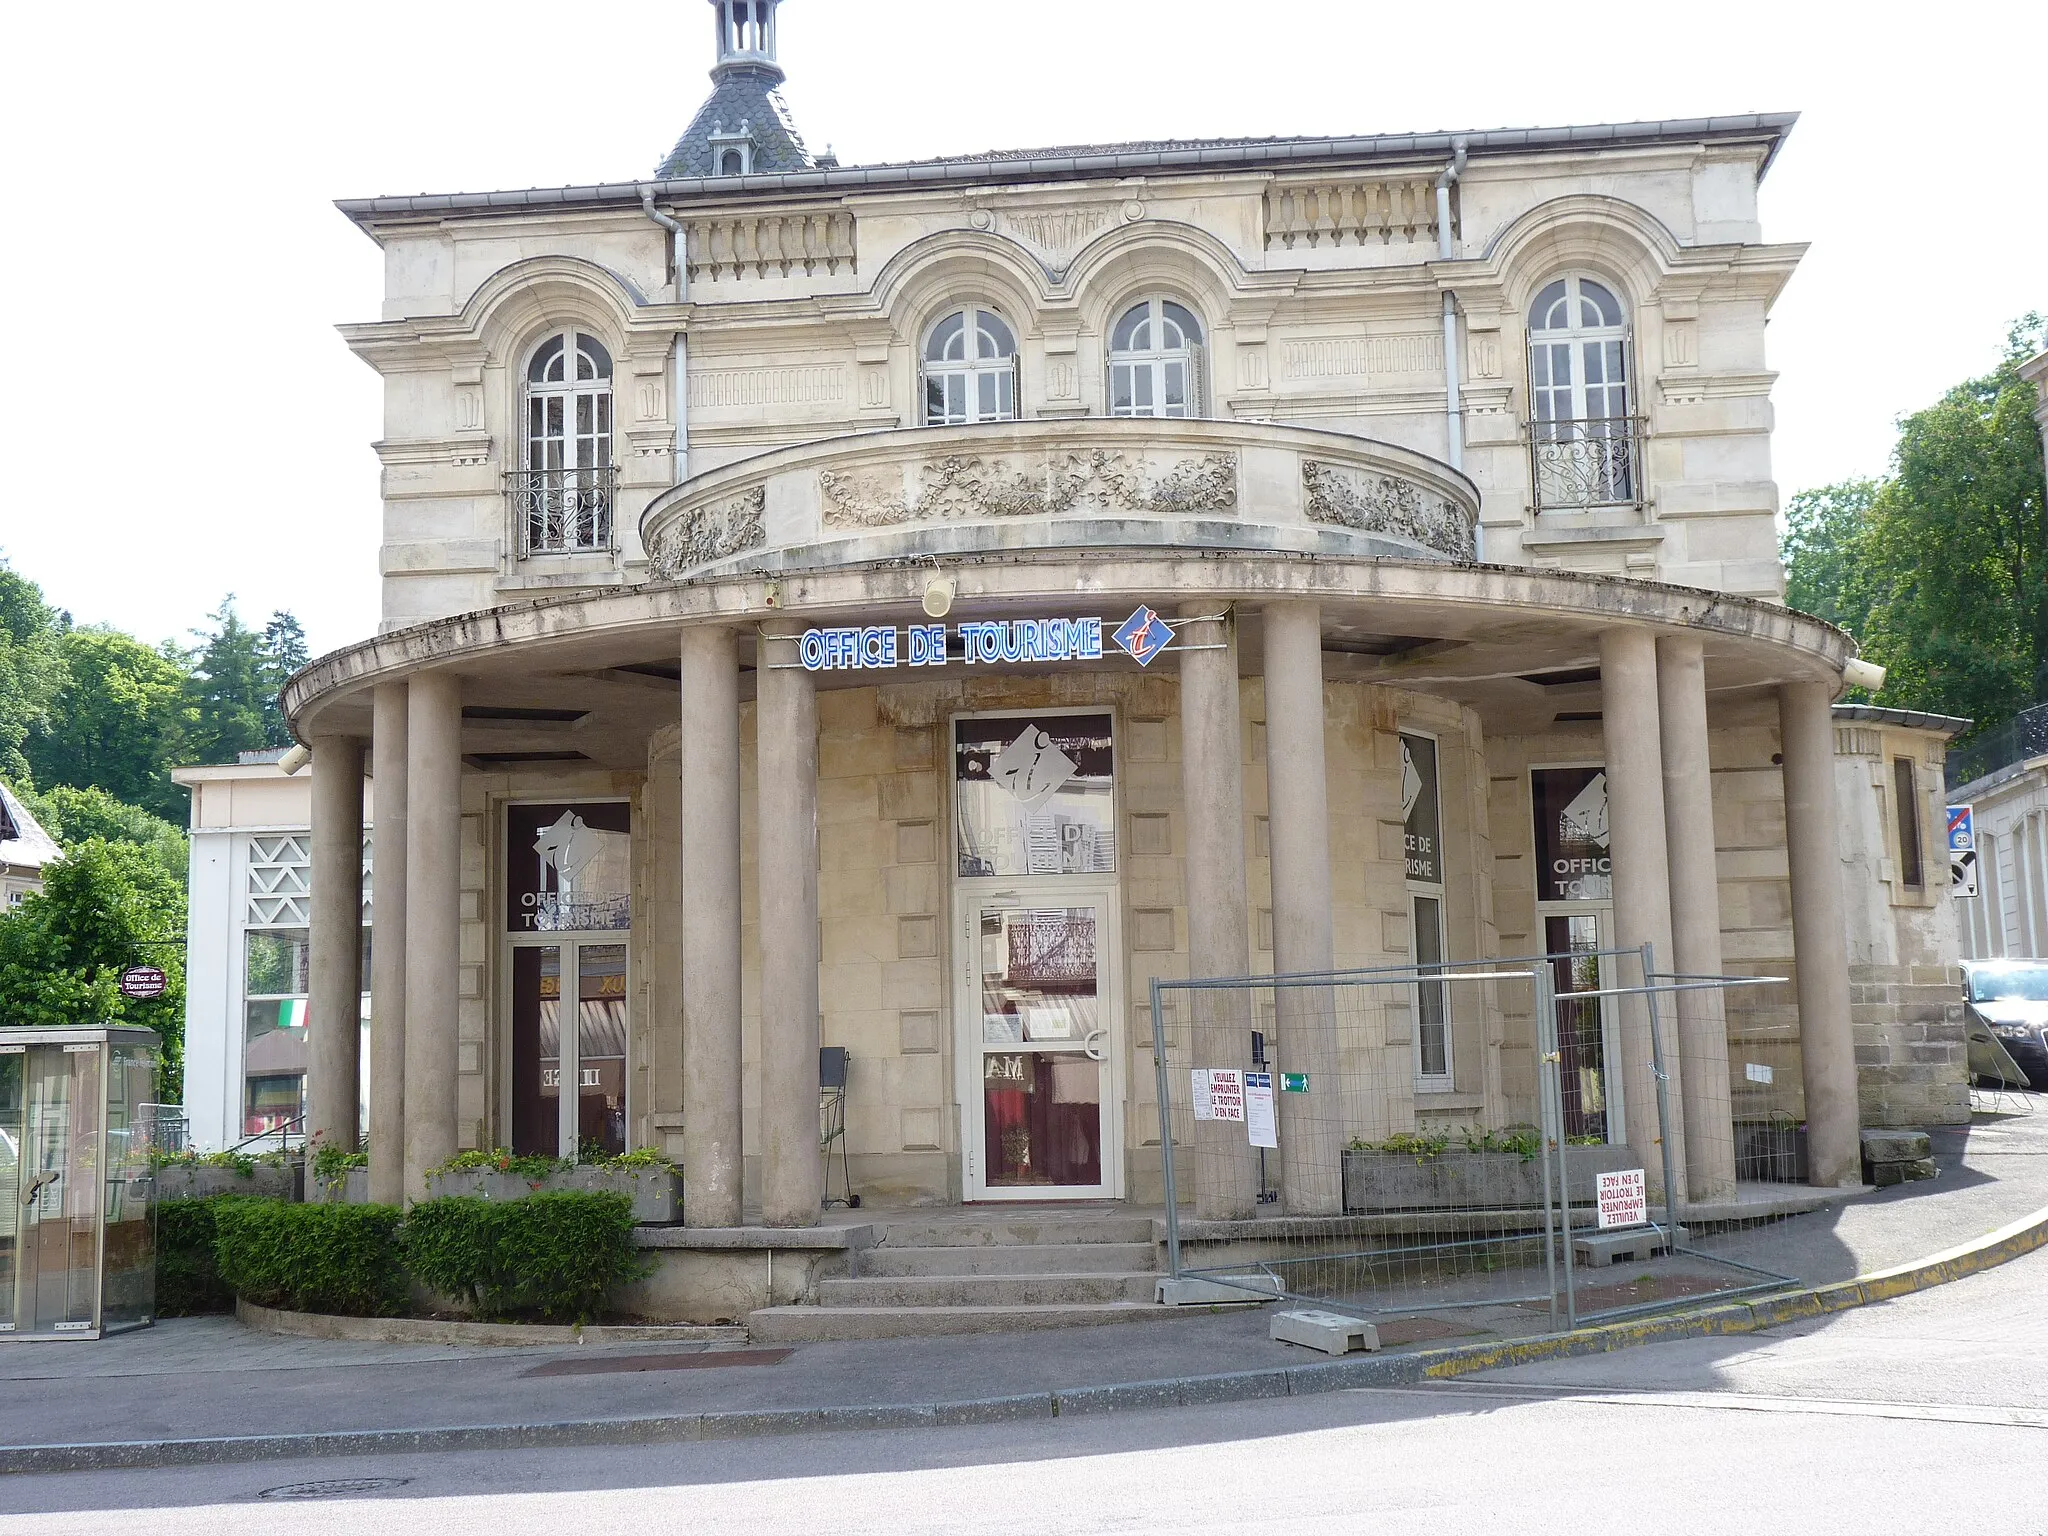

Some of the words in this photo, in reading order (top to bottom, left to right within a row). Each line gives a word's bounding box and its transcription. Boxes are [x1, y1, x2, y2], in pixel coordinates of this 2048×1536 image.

[801, 626, 897, 671] OFFICE
[908, 624, 946, 666] DE
[957, 616, 1102, 664] TOURISME
[1419, 836, 1431, 853] DE
[1957, 836, 1968, 844] 20
[125, 982, 162, 990] Tourisme
[1213, 1072, 1236, 1083] VEUILLEZ
[1210, 1083, 1240, 1094] EMPRUNTER
[1211, 1095, 1217, 1105] LE
[1218, 1096, 1242, 1106] TROTTOIR
[1228, 1108, 1240, 1118] FACE
[1602, 1176, 1619, 1188] FACE
[1622, 1173, 1639, 1185] D'EN
[1600, 1187, 1634, 1200] TROTTOIR
[1636, 1185, 1644, 1196] LE
[1600, 1198, 1643, 1213] EMPRUNTER
[1607, 1211, 1639, 1224] VEUILLEZ
